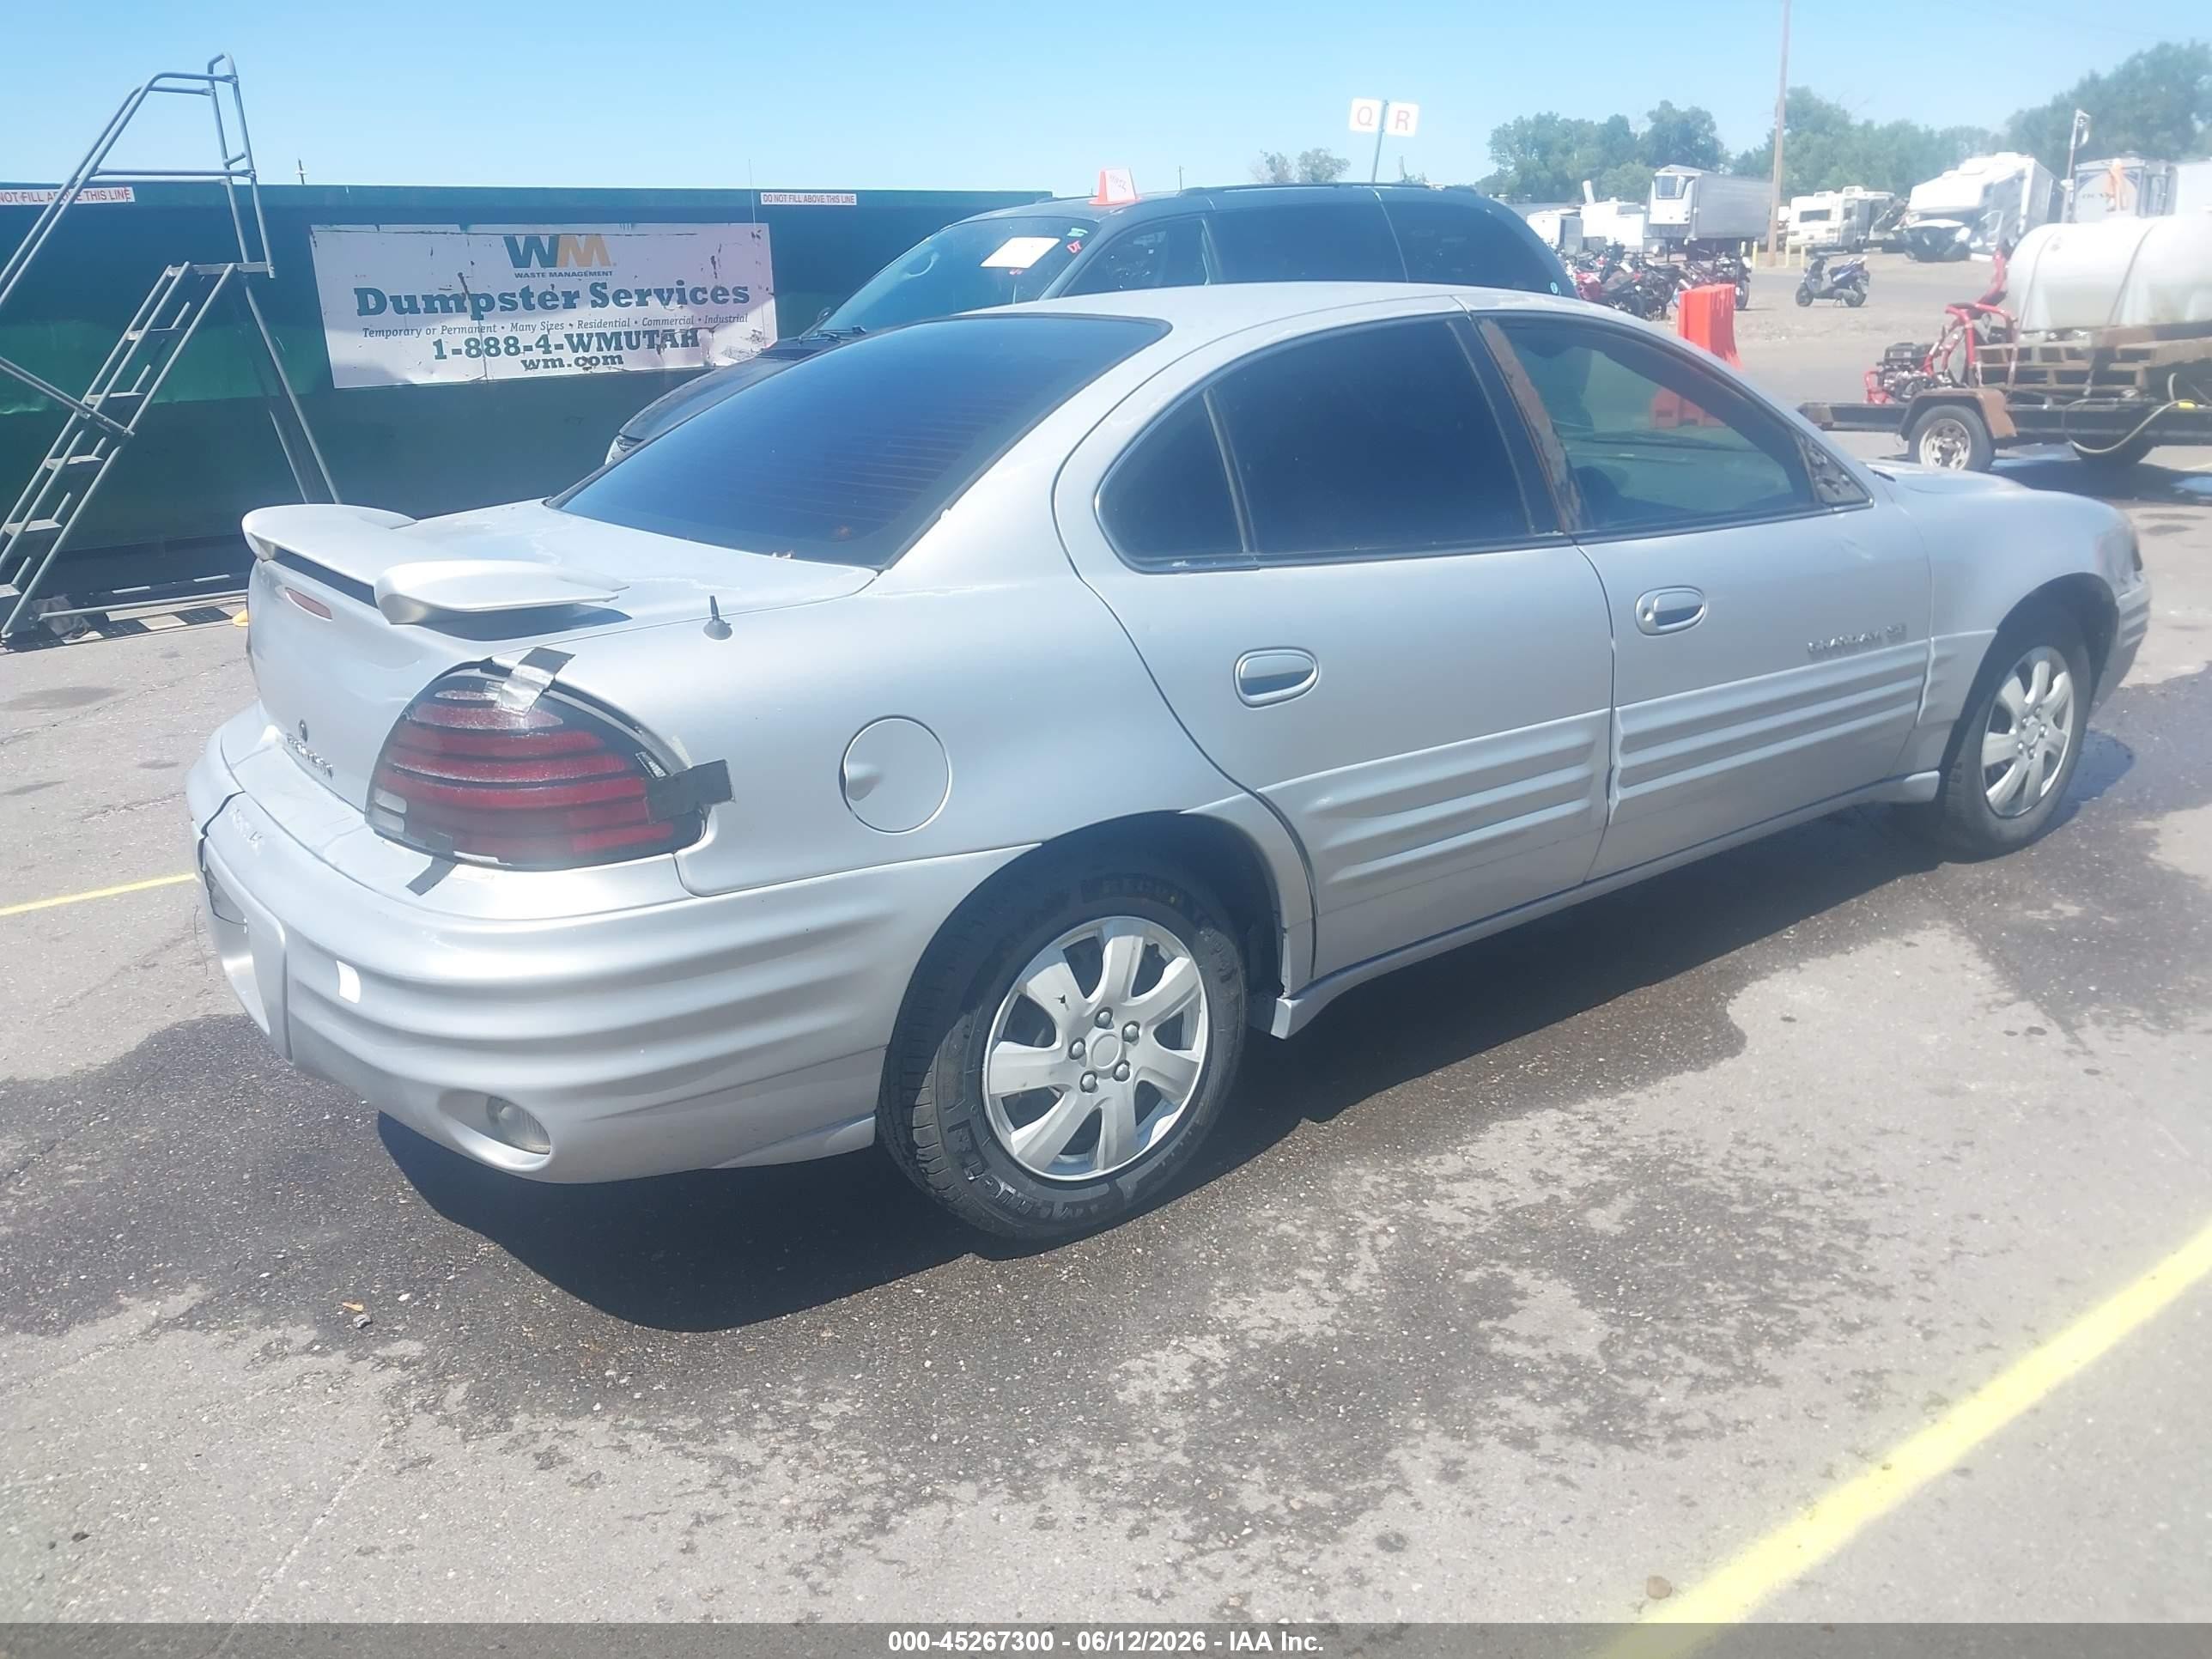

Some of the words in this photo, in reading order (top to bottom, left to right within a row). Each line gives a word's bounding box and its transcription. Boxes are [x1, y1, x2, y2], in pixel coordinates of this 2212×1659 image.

[1358, 106, 1372, 126] Q
[1395, 110, 1410, 131] R
[21, 191, 44, 202] FILL
[83, 190, 107, 202] THIS
[108, 189, 131, 201] LINE
[774, 194, 787, 203] NOT
[788, 194, 802, 203] FILL
[804, 194, 824, 204] ABOVE
[826, 195, 840, 204] THIS
[842, 195, 854, 204] LINE
[502, 234, 611, 268] WM
[354, 284, 580, 320] Dumpster
[589, 280, 750, 308] Services
[362, 326, 422, 339] Temporary
[441, 324, 496, 335] Permanent
[509, 322, 537, 334] Many
[540, 320, 564, 331] Sizes
[577, 318, 630, 330] Residential
[642, 314, 694, 327] Commercial
[704, 313, 748, 324] Industrial
[433, 329, 700, 360] 1-888-4-WMUTAH
[521, 354, 623, 371] wm.com
